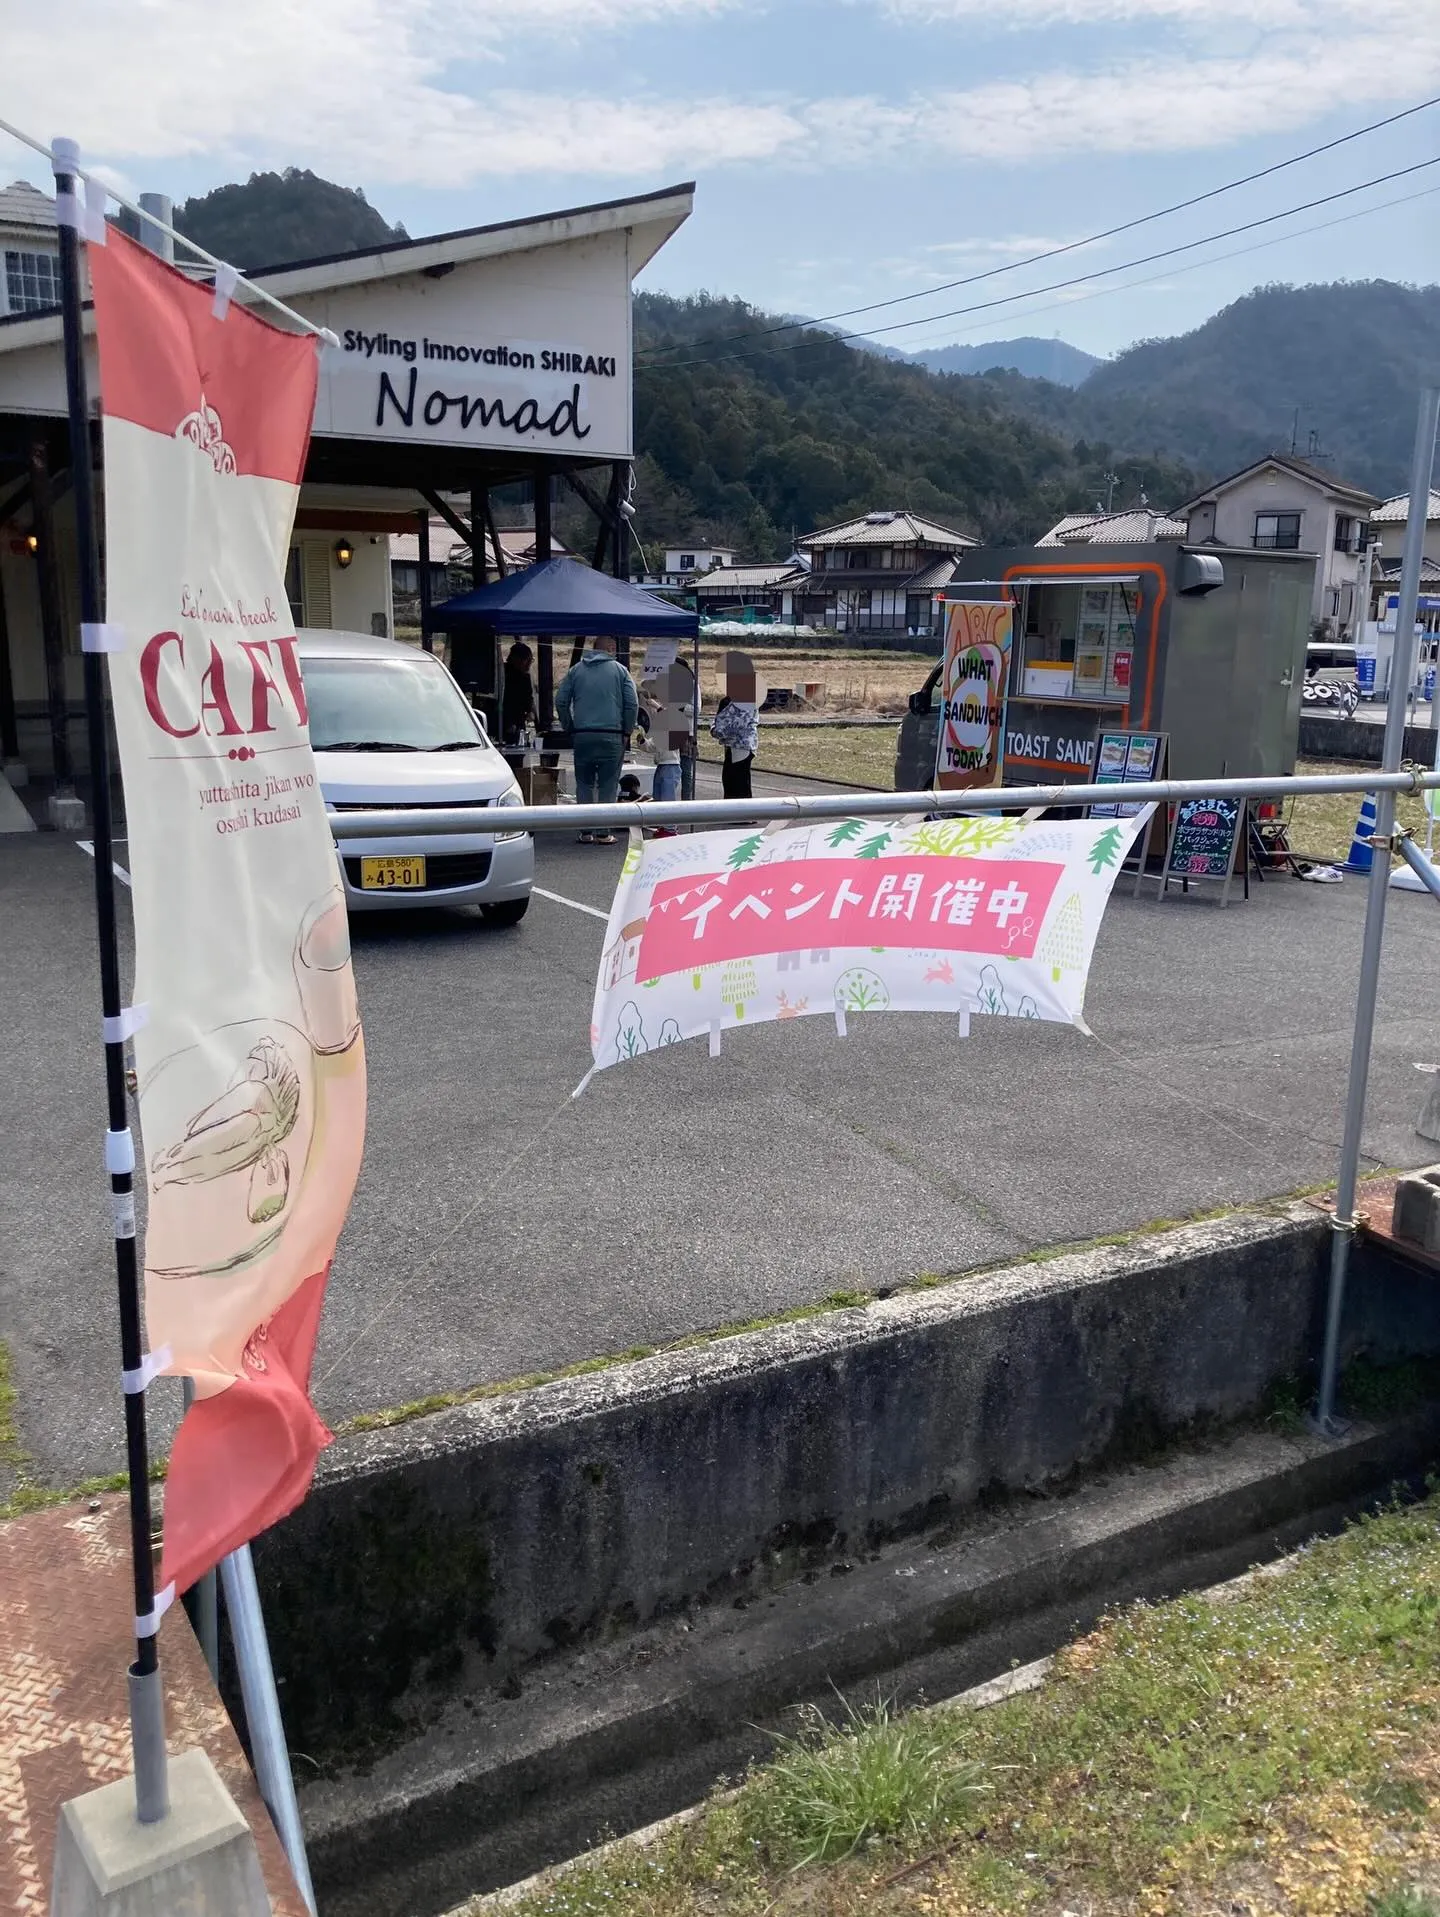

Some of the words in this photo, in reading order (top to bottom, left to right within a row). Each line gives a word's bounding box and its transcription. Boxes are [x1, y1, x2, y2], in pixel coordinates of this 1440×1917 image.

[343, 328, 417, 362] Styling
[423, 337, 535, 369] innovation
[541, 350, 616, 377] SHIRAKI
[376, 366, 591, 439] Nomad
[237, 596, 278, 626] break
[957, 657, 994, 682] WHAT
[943, 700, 1004, 728] SANDWICH
[1007, 731, 1051, 760] TOAST
[263, 776, 293, 801] jikan
[294, 773, 314, 788] wo
[253, 800, 302, 827] kudasai
[376, 869, 420, 886] 43-01
[678, 872, 1030, 941] イベント開催中
